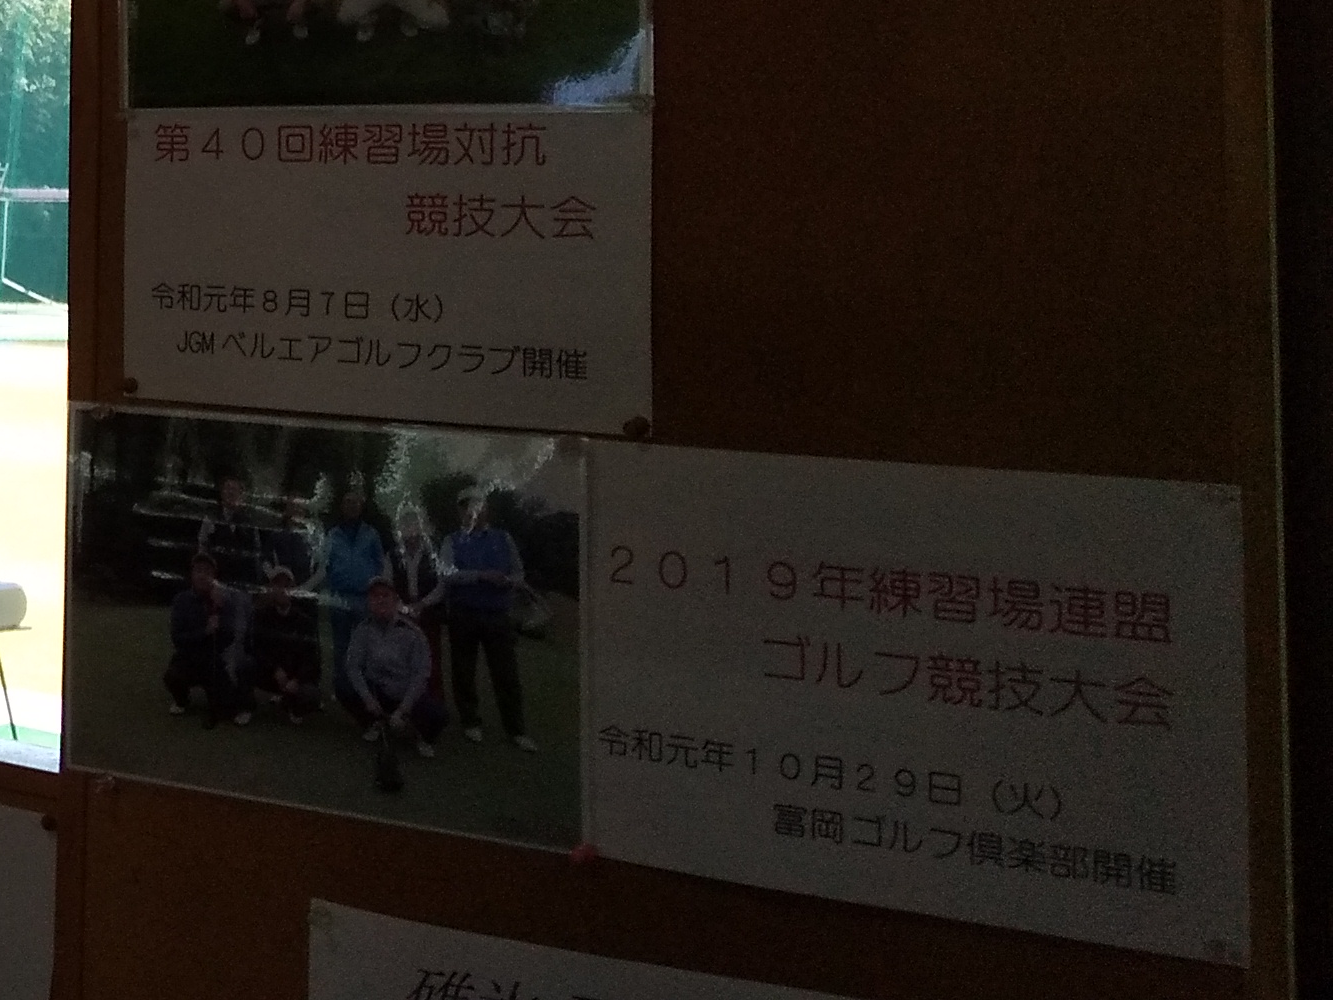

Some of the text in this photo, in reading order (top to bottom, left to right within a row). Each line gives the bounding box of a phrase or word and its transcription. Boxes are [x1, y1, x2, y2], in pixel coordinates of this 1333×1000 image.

[153, 122, 547, 168] 第40回練習場対抗
[404, 193, 597, 240] 競技大会
[610, 544, 1173, 643] 2019年練習場連盟
[763, 635, 1172, 730] ゴルフ競技大会
[773, 803, 1176, 895] 富岡ゴルフ倶楽部開催
